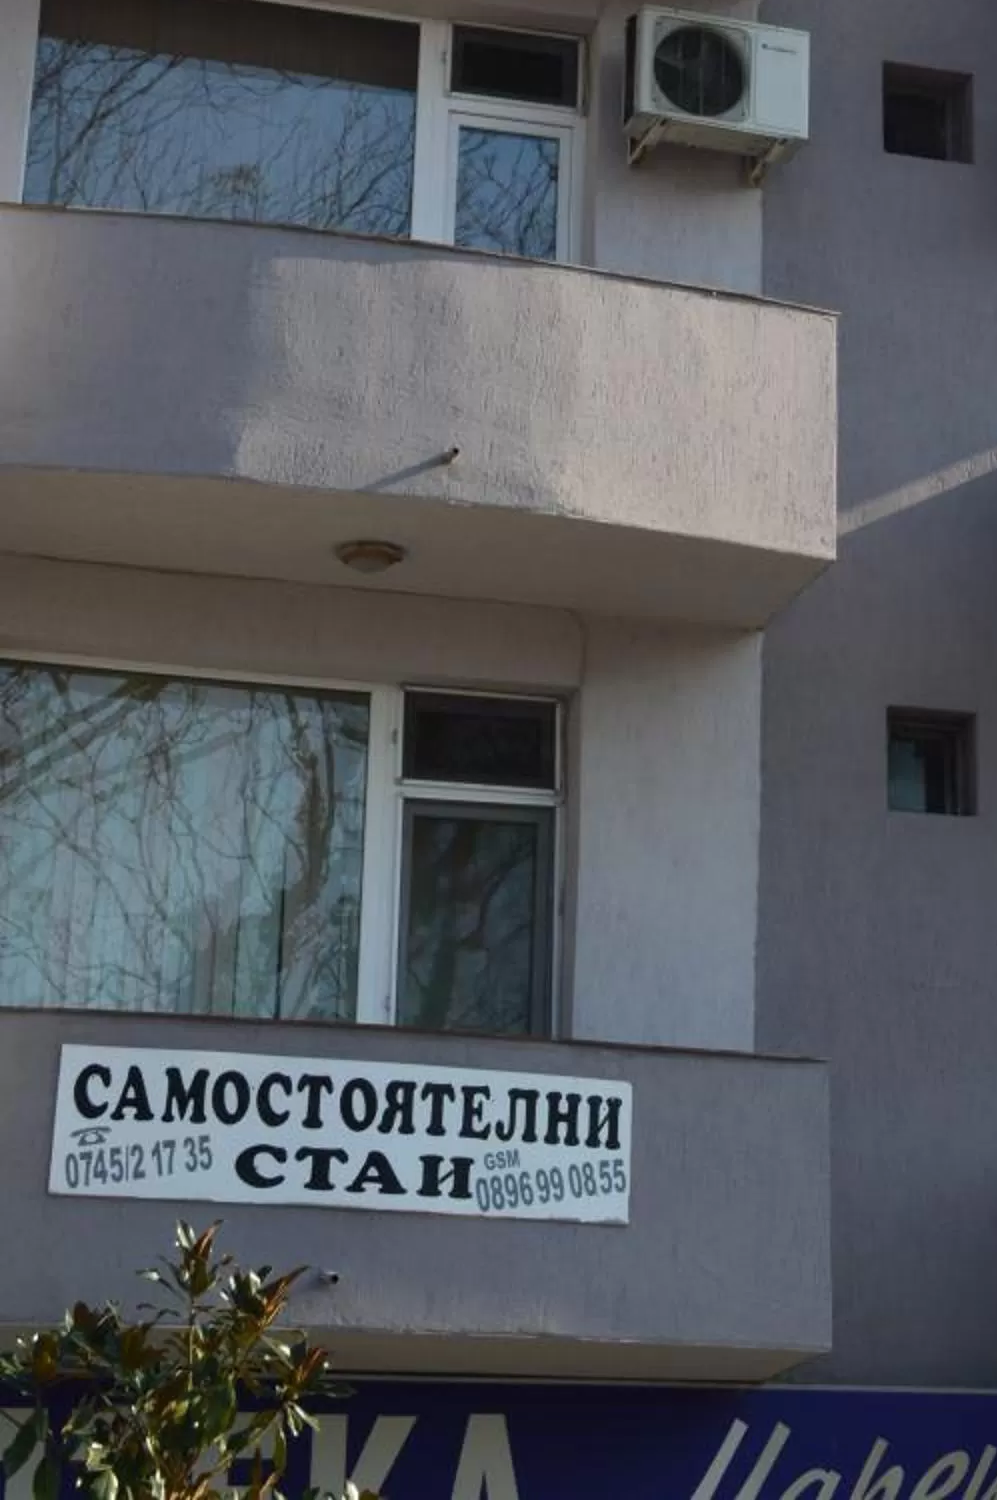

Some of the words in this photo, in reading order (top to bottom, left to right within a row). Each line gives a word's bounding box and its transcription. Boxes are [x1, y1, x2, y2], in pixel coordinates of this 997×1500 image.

[73, 1063, 623, 1150] САМОСТОЯТЕЛНИ
[151, 1139, 176, 1176] 17
[183, 1135, 213, 1172] 35
[234, 1144, 476, 1199] СТАИ
[483, 1149, 521, 1171] GSM
[568, 1162, 597, 1198] 08
[599, 1159, 627, 1193] 55
